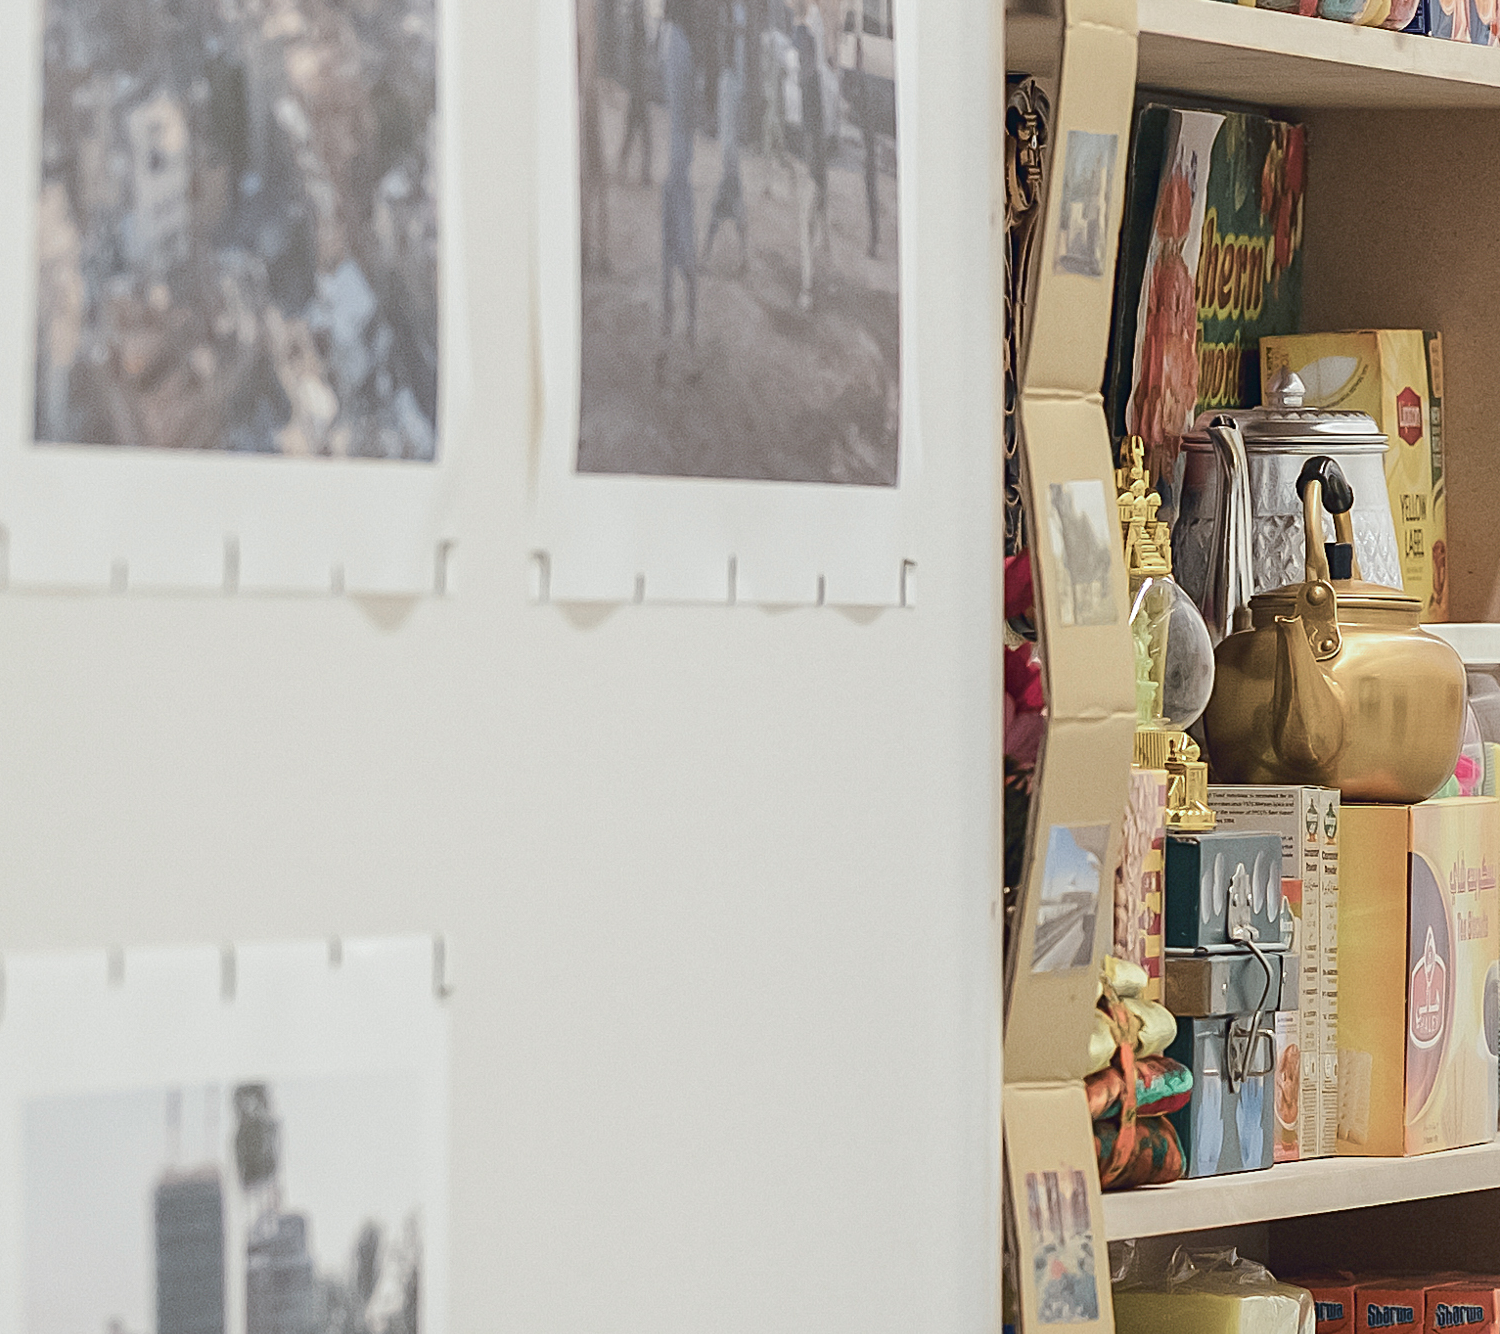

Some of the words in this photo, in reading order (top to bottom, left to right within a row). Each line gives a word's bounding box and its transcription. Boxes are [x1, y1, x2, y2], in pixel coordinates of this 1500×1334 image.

[1399, 493, 1427, 523] YELLOW
[1405, 528, 1425, 558] LABEL
[1315, 1301, 1344, 1321] arwa
[1367, 1304, 1414, 1328] Sharwa
[1435, 1304, 1484, 1328] Sharwa
